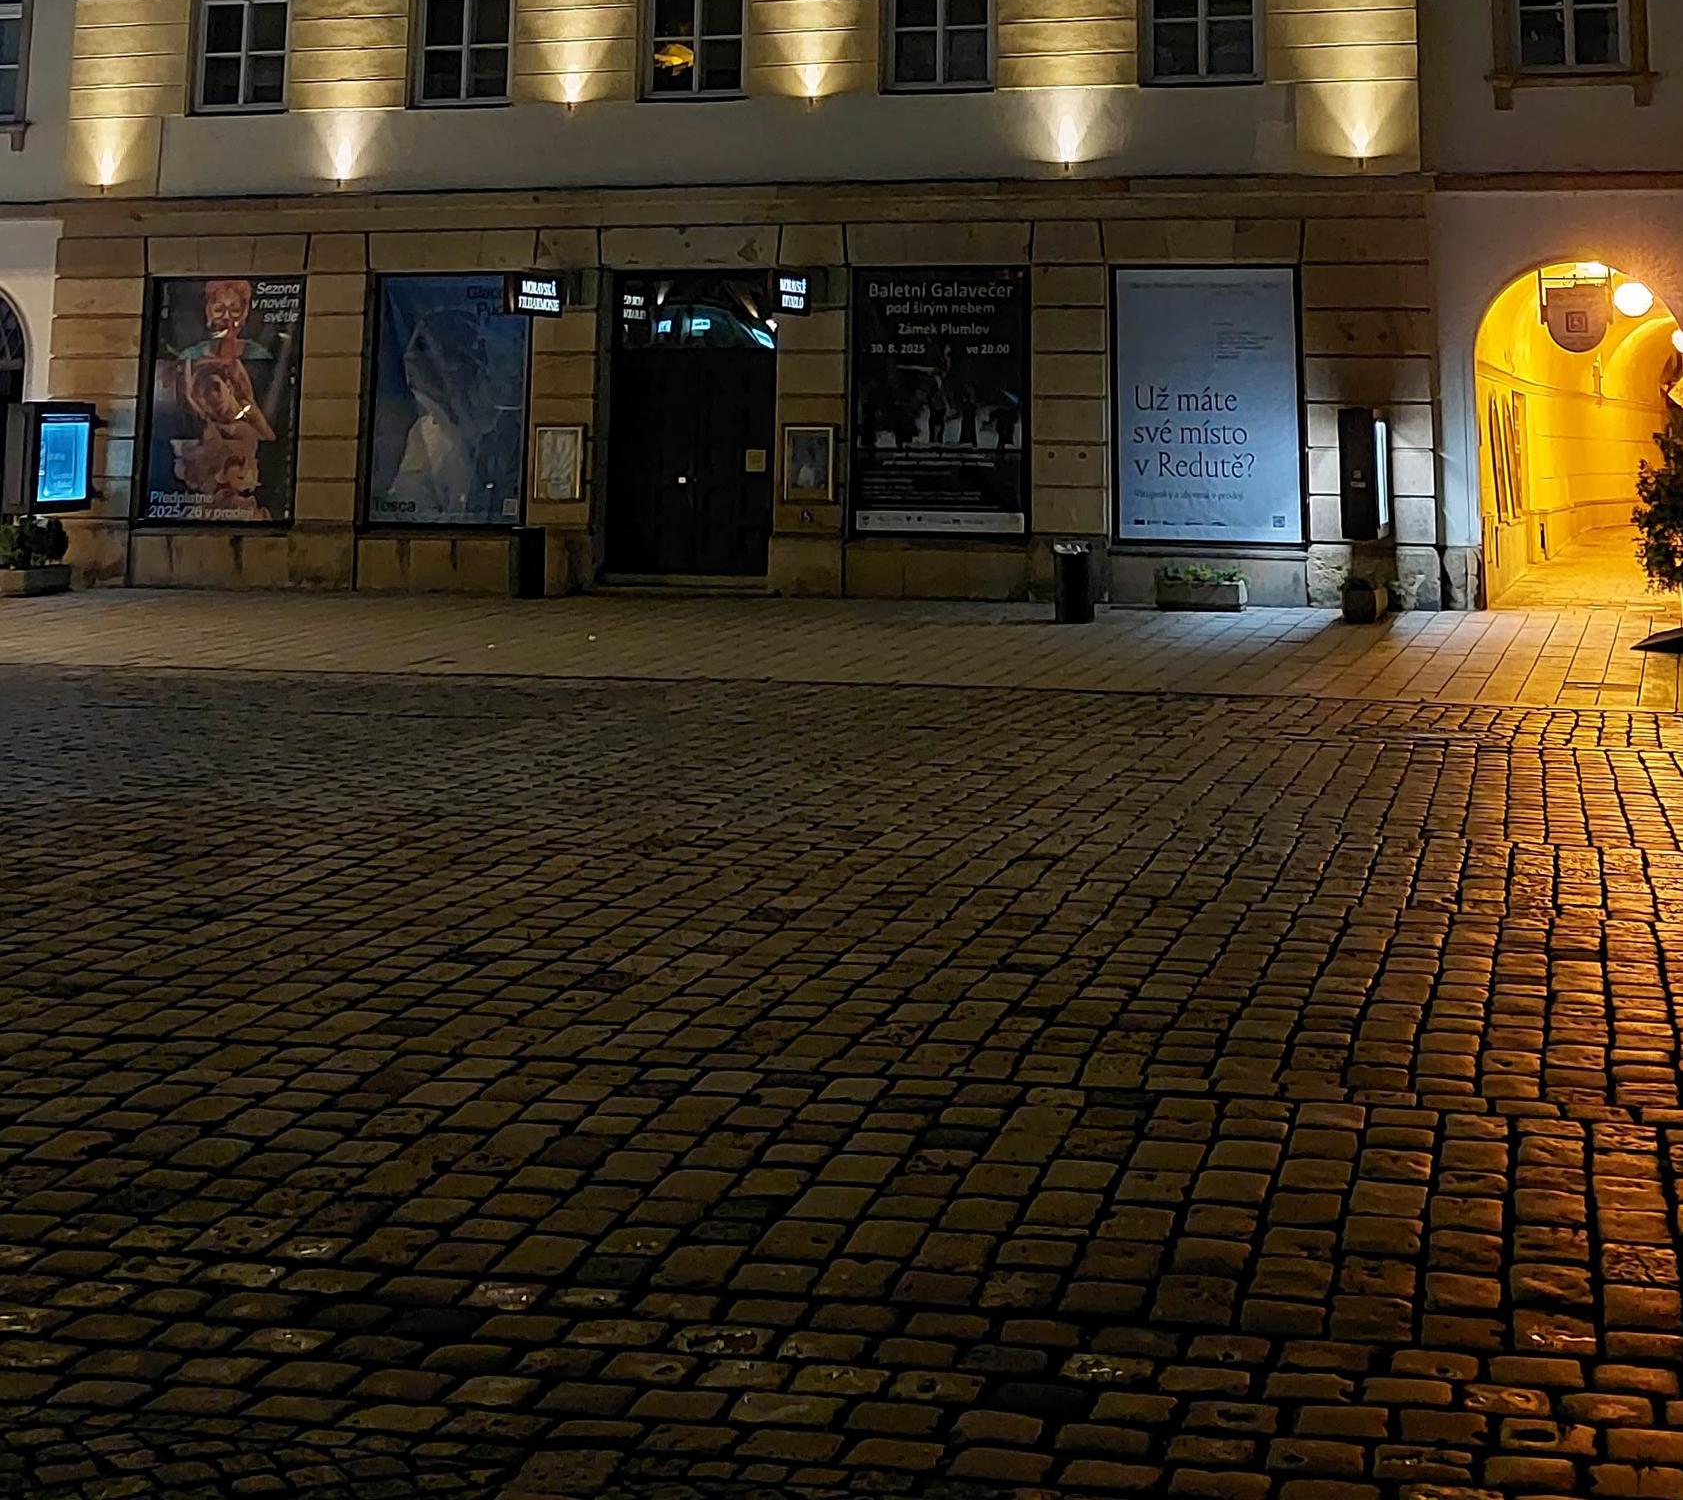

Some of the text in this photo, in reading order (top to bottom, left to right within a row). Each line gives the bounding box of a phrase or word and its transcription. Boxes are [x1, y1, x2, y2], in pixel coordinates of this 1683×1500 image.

[256, 281, 300, 295] Sezona
[868, 281, 1014, 298] Baletní Galavečer
[251, 296, 299, 309] v novém
[886, 301, 910, 316] pod
[951, 301, 995, 315] nebem
[897, 322, 990, 336] Zámek Plumlov
[900, 343, 926, 354] 2025
[1134, 385, 1238, 411] Už máte
[1132, 419, 1247, 445] své místo
[1134, 451, 1255, 478] v Redutě?
